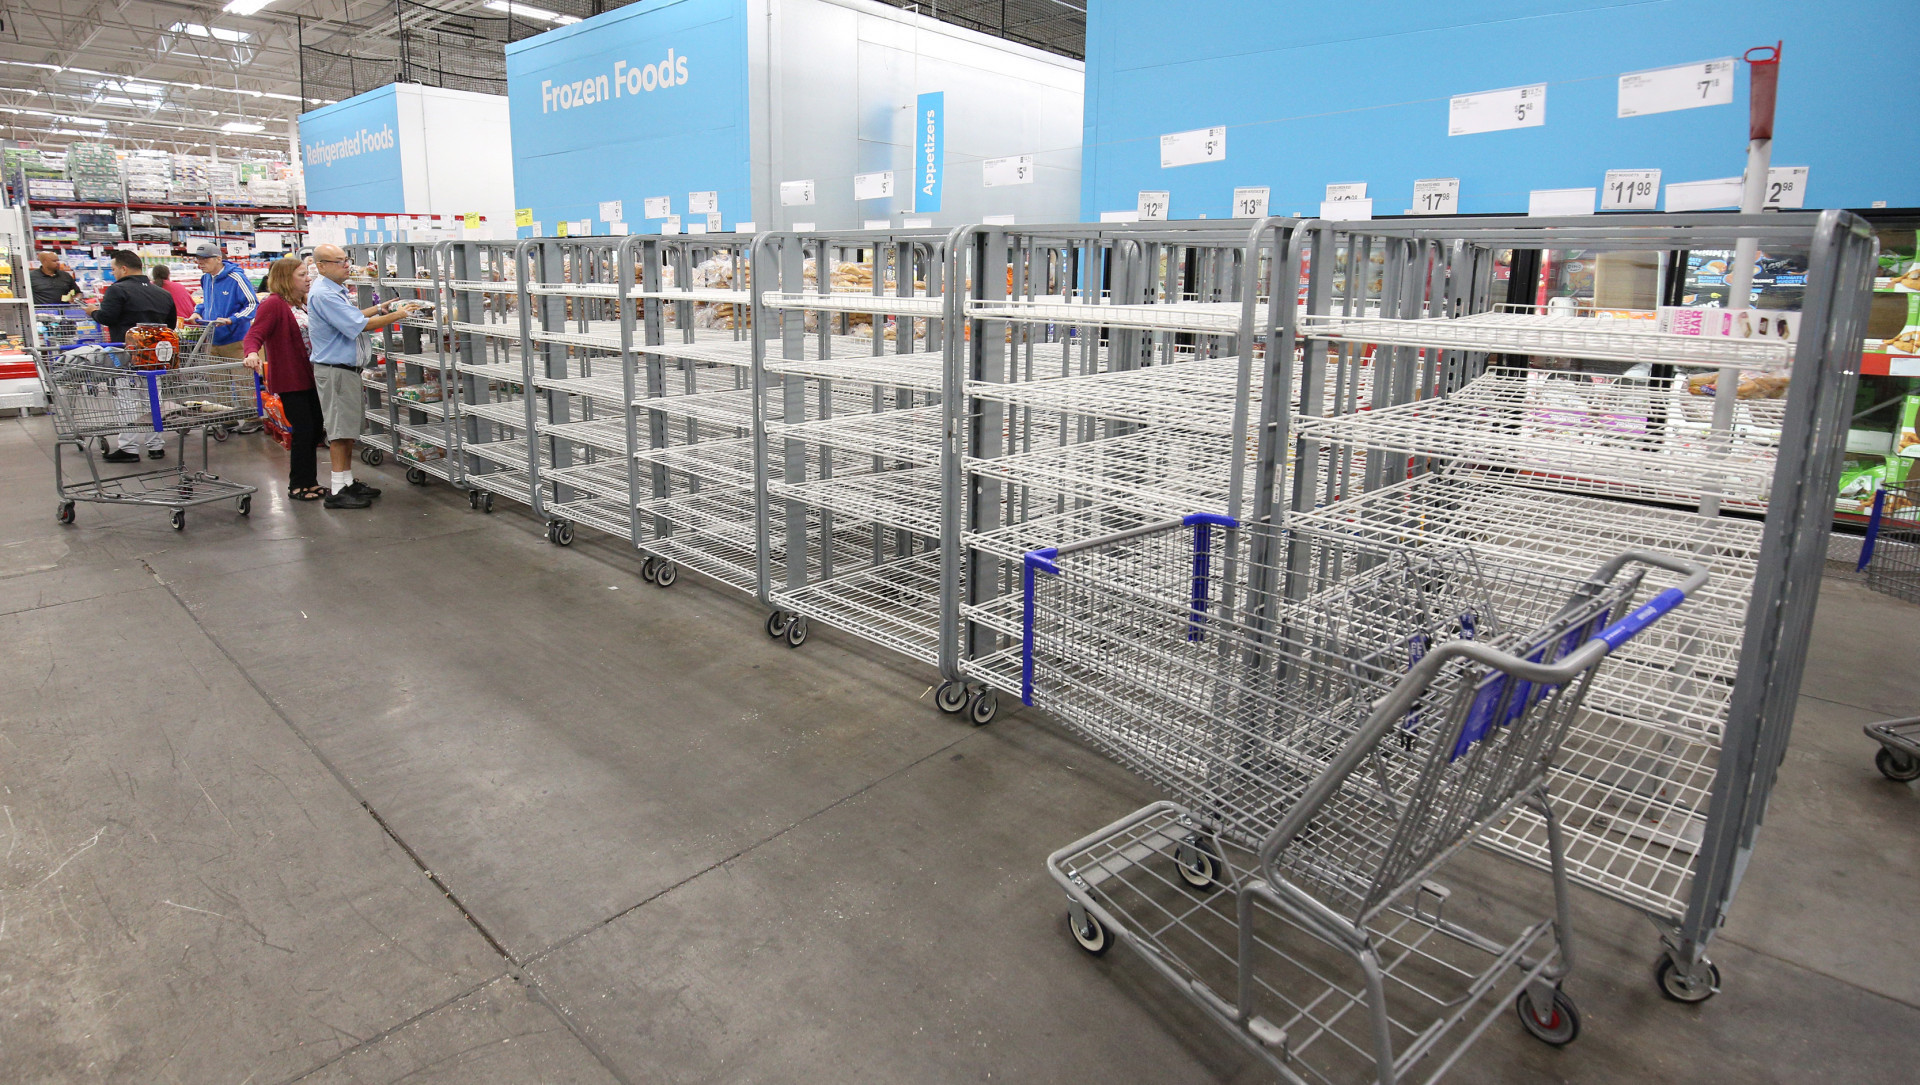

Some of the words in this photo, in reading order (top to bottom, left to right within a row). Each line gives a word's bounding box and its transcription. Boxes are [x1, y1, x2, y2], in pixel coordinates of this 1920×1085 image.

[542, 80, 609, 114] Frozen
[614, 48, 689, 99] Foods
[306, 130, 361, 167] Refrigerated
[361, 123, 394, 153] Foods
[922, 109, 936, 196] Appetizers
[1689, 310, 1704, 336] BAR
